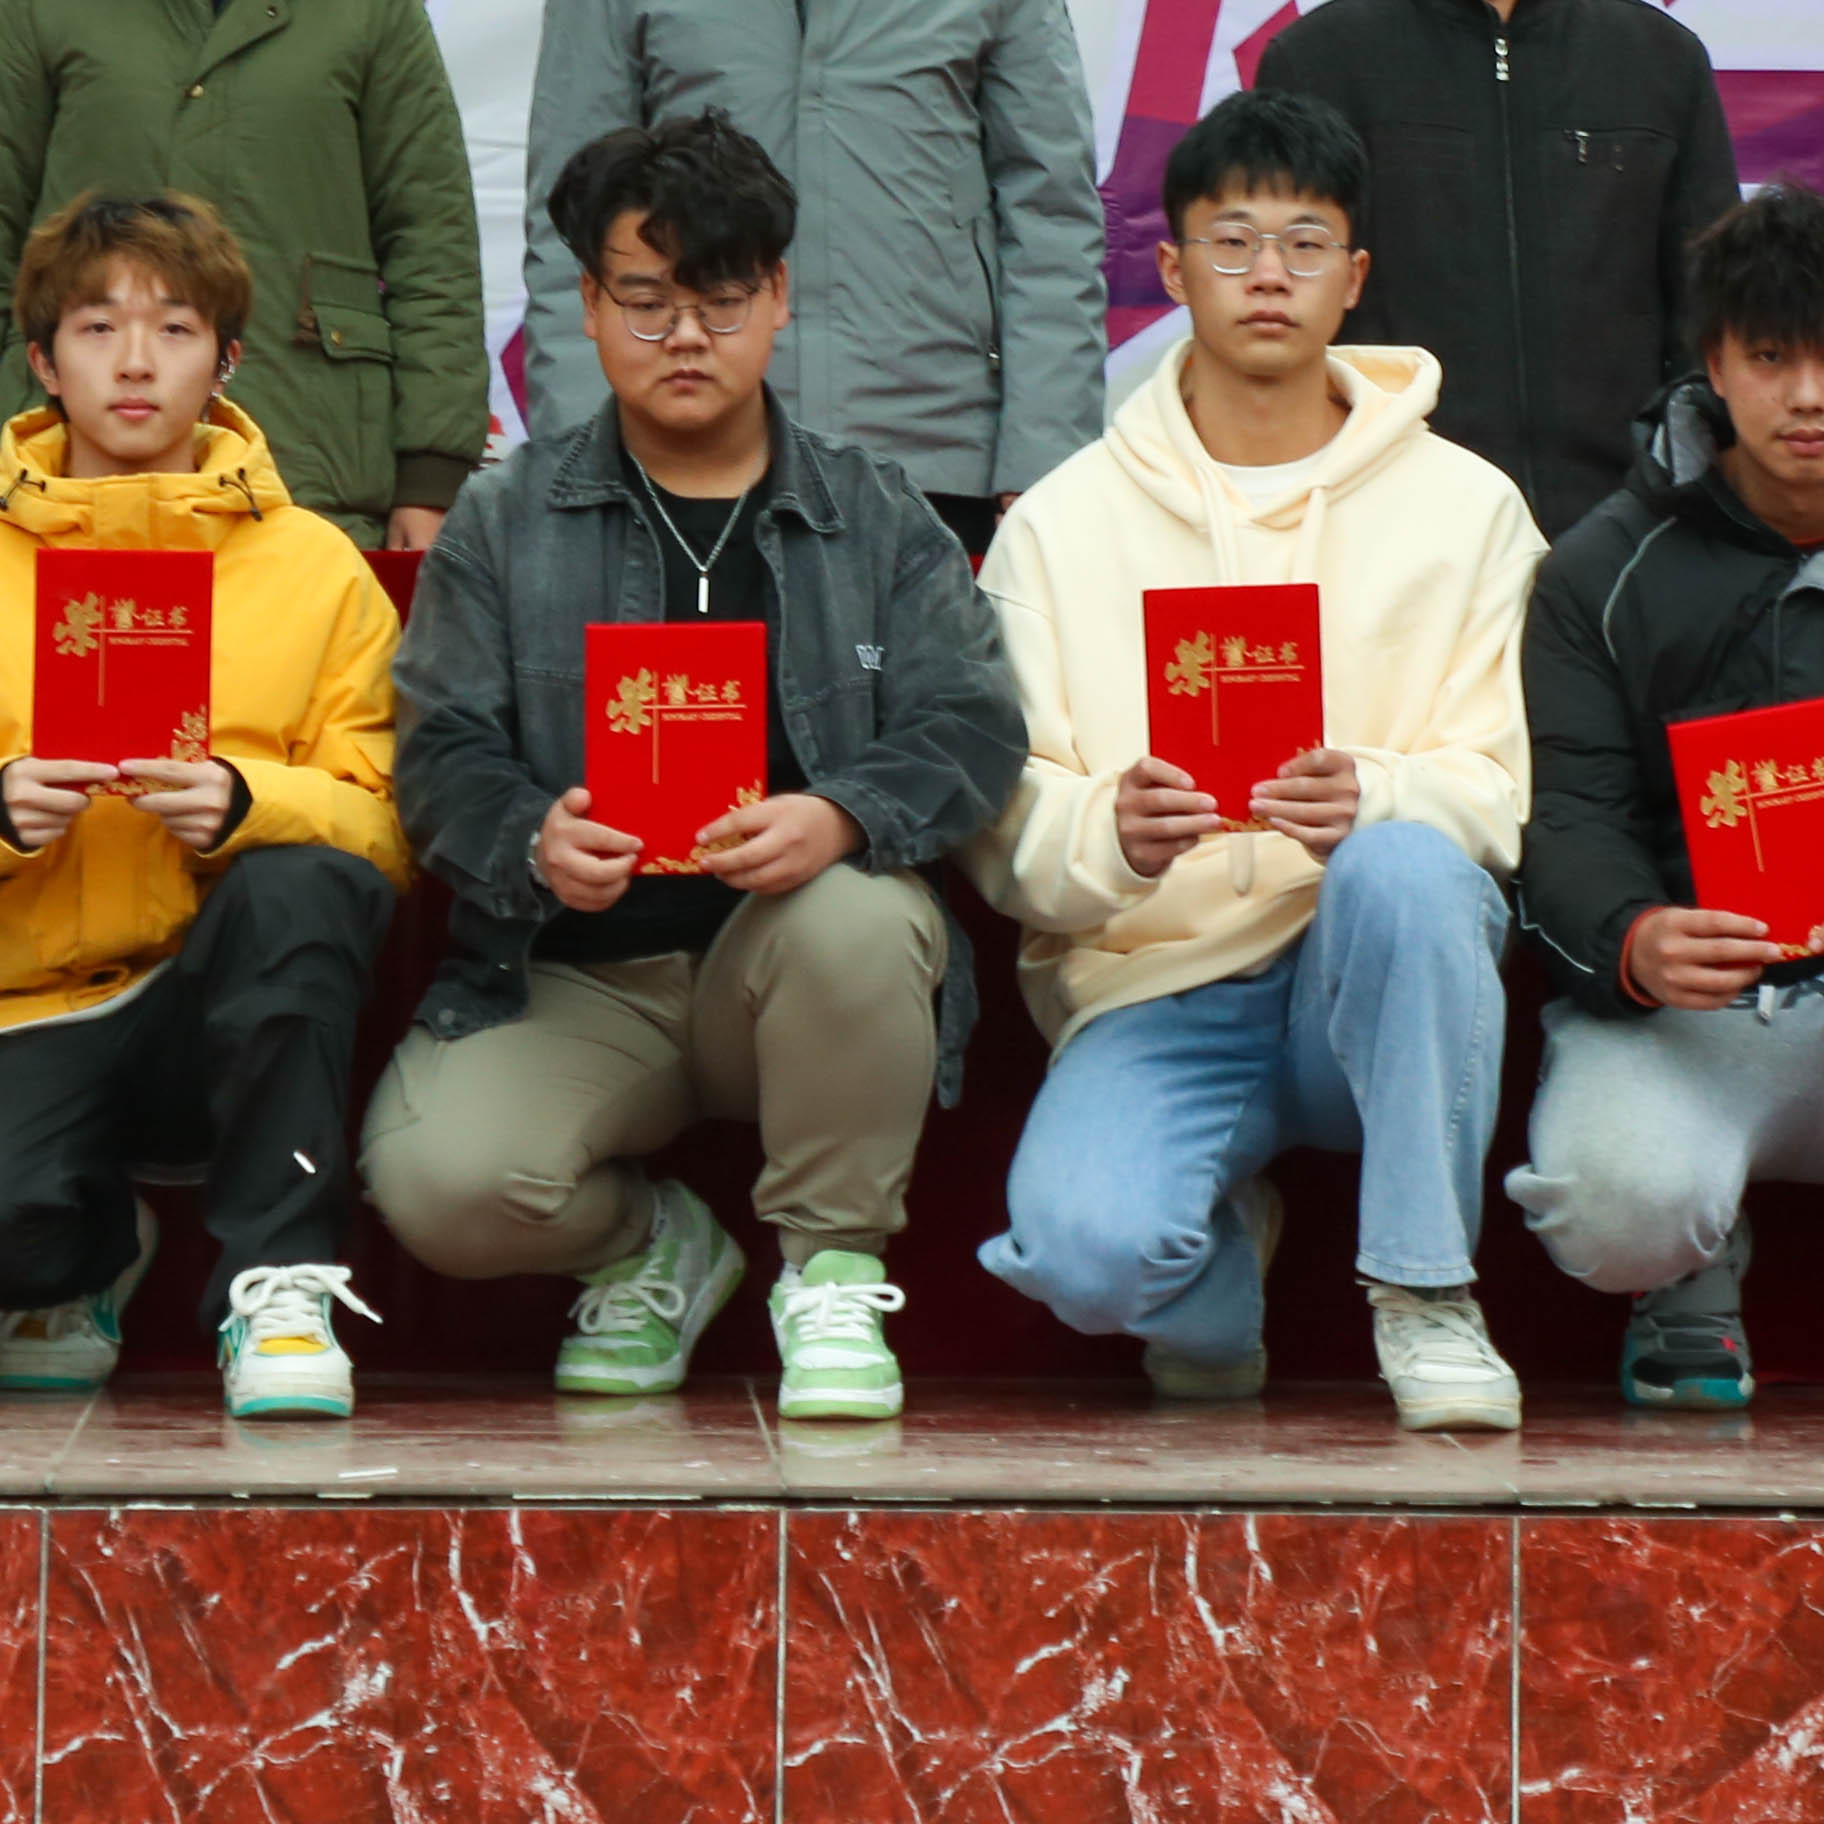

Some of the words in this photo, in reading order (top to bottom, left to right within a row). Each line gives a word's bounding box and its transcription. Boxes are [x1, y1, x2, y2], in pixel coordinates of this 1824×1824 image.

[52, 591, 189, 657] 荣誉证书
[1164, 630, 1299, 697] 荣誉证书
[606, 667, 742, 735] 荣誉证书
